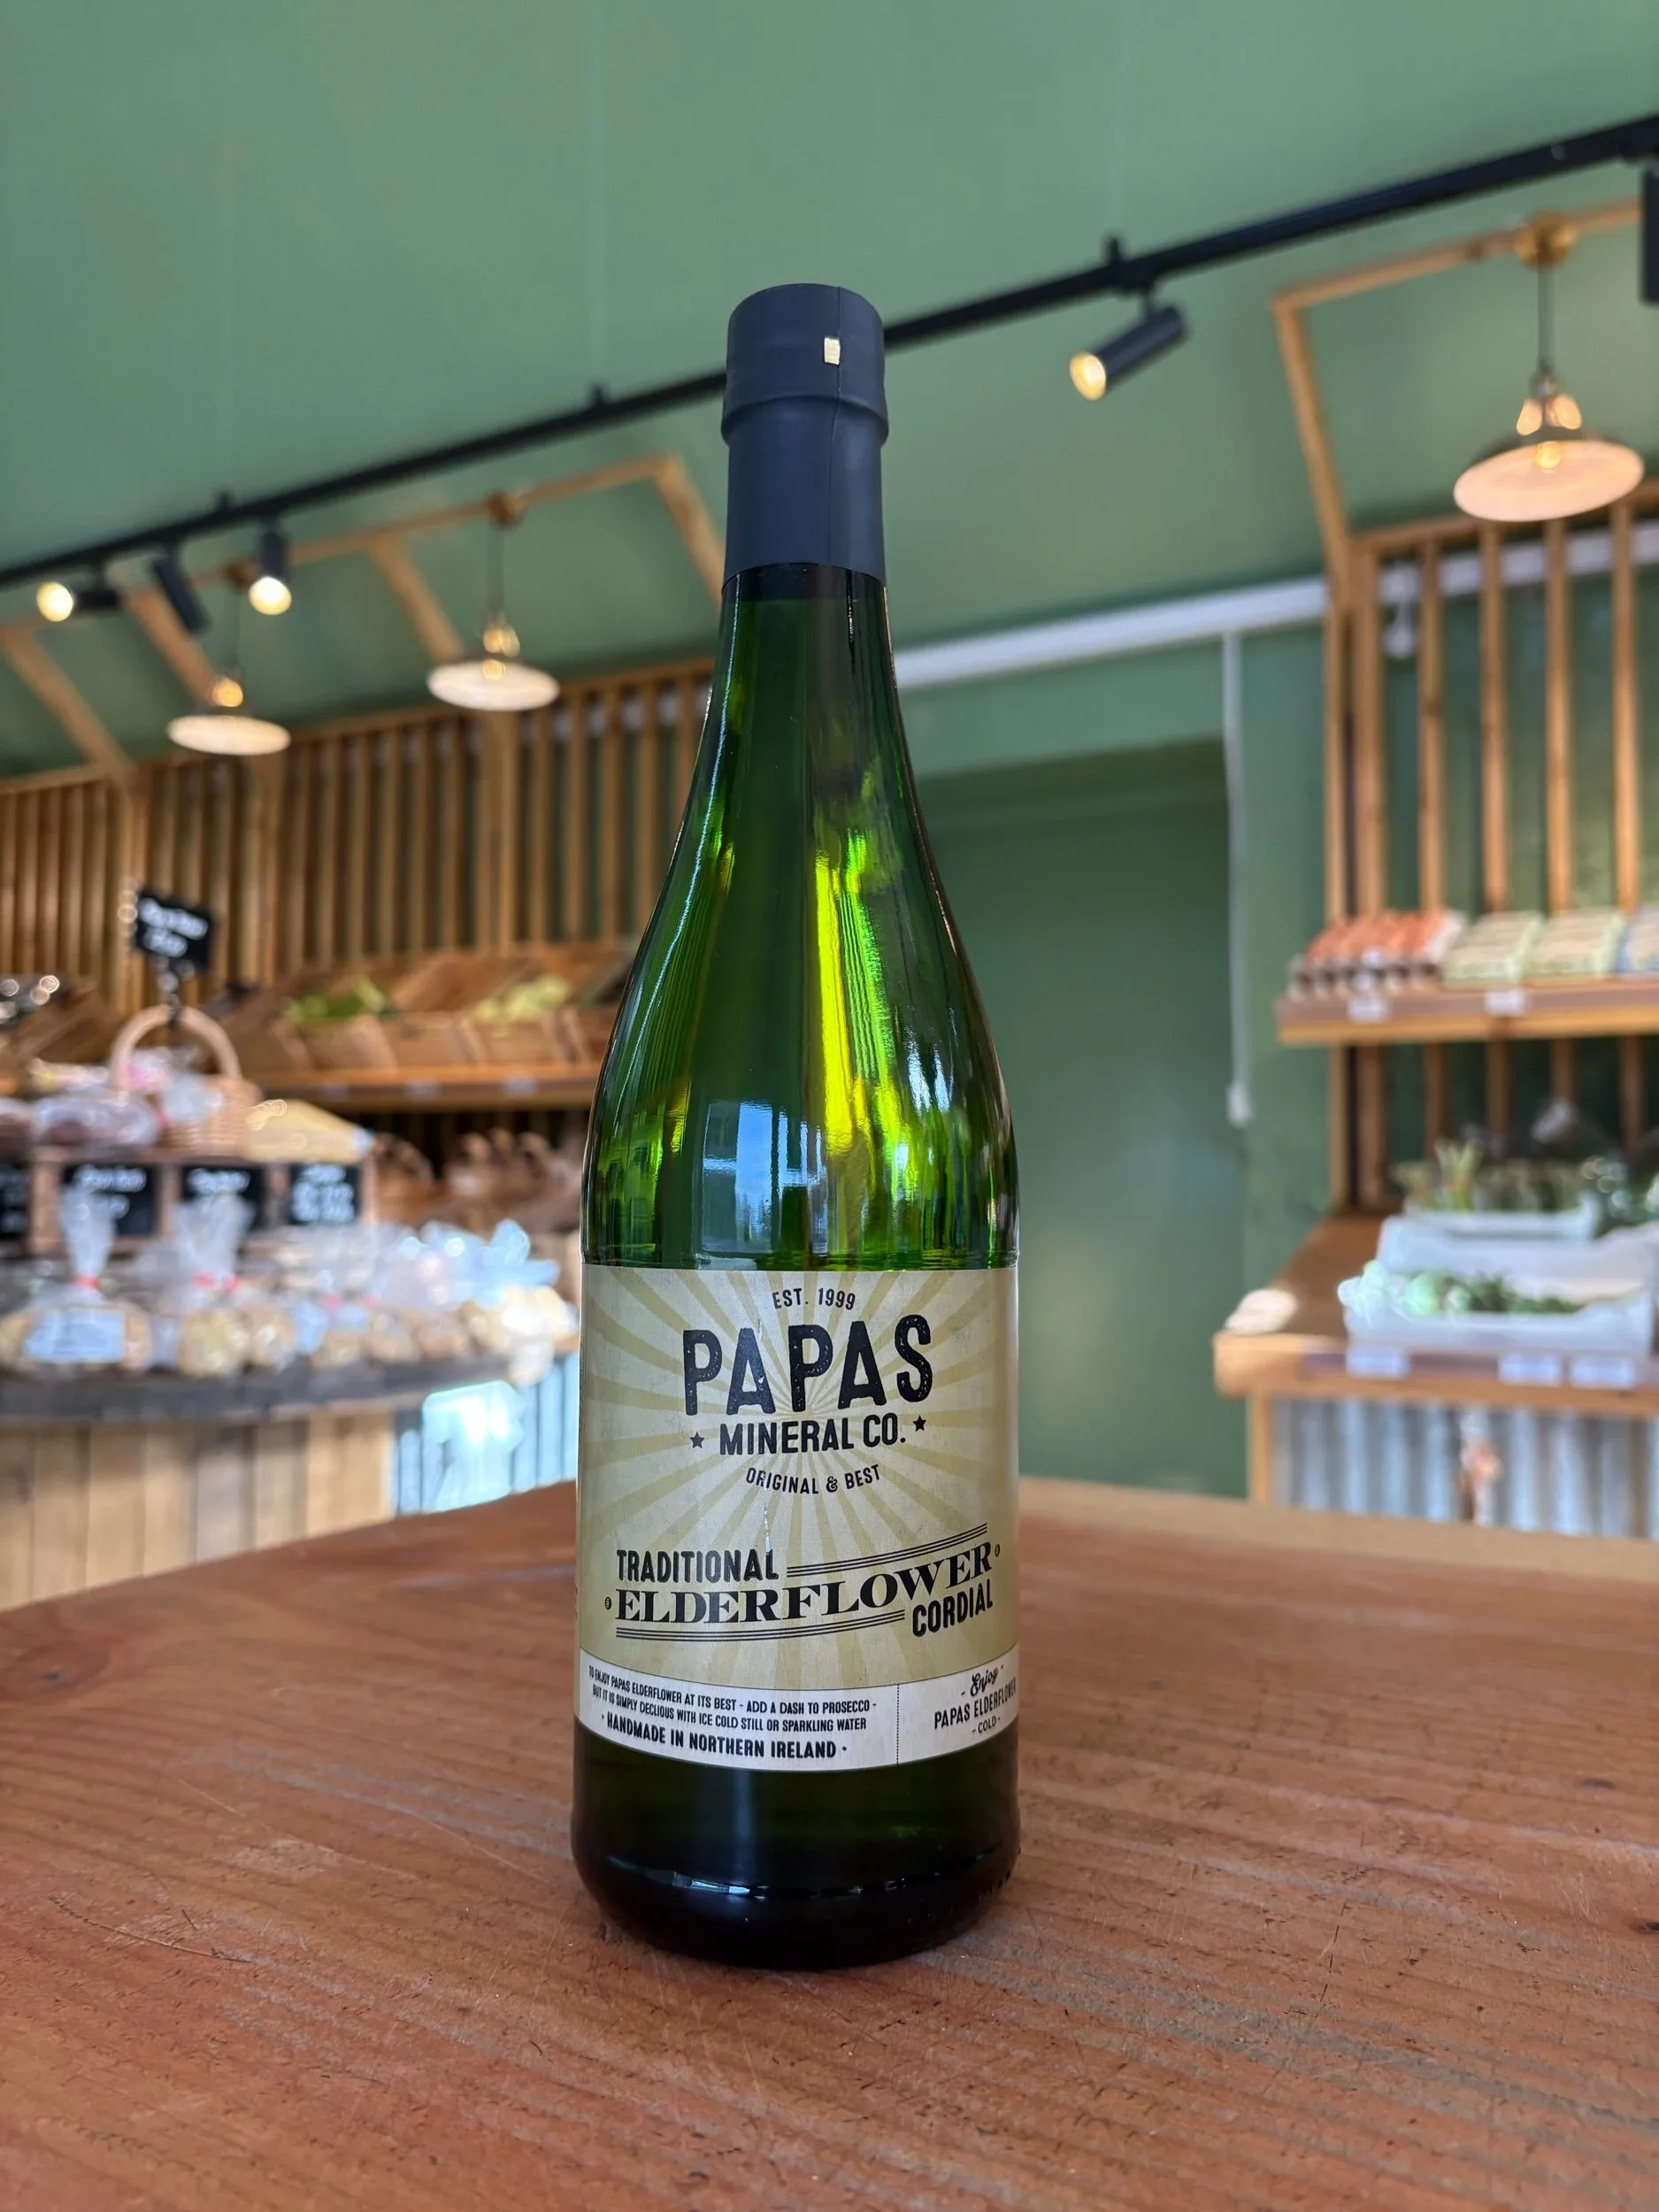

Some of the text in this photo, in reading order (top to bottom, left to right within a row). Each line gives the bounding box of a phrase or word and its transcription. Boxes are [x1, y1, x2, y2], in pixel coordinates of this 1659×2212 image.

[817, 1286, 857, 1311] 1999
[682, 1313, 933, 1417] PAPAS
[718, 1412, 907, 1456] MINERAL CO.
[744, 1463, 882, 1495] ORIGINAL & BEST
[614, 1540, 995, 1624] ELDERFLOWER
[616, 1548, 780, 1584] TRADITIONAL
[911, 1578, 995, 1638] CORDIAL
[595, 1668, 611, 1686] ENJOY
[611, 1676, 631, 1694] PAPAS
[632, 1682, 682, 1704] ELDERFLOWER
[684, 1693, 695, 1706] AT
[697, 1694, 711, 1709] ITS
[713, 1697, 737, 1711] BEST
[746, 1700, 768, 1714] ADD
[770, 1701, 776, 1714] A
[780, 1701, 804, 1715] DASH
[807, 1701, 819, 1715] TO
[822, 1699, 870, 1715] PROSECCO
[933, 1677, 1017, 1730] PAPAS ELDERFLOWER
[970, 1666, 999, 1697] Enjoy
[592, 1683, 867, 1732] BUT IT IS SIMPLY DECLIOUS WITH ICE COLD STILL OR SPARKLING WATER
[978, 1716, 997, 1734] COLD
[607, 1711, 837, 1759] HANDMADE IN NORTHERN IRELAND
